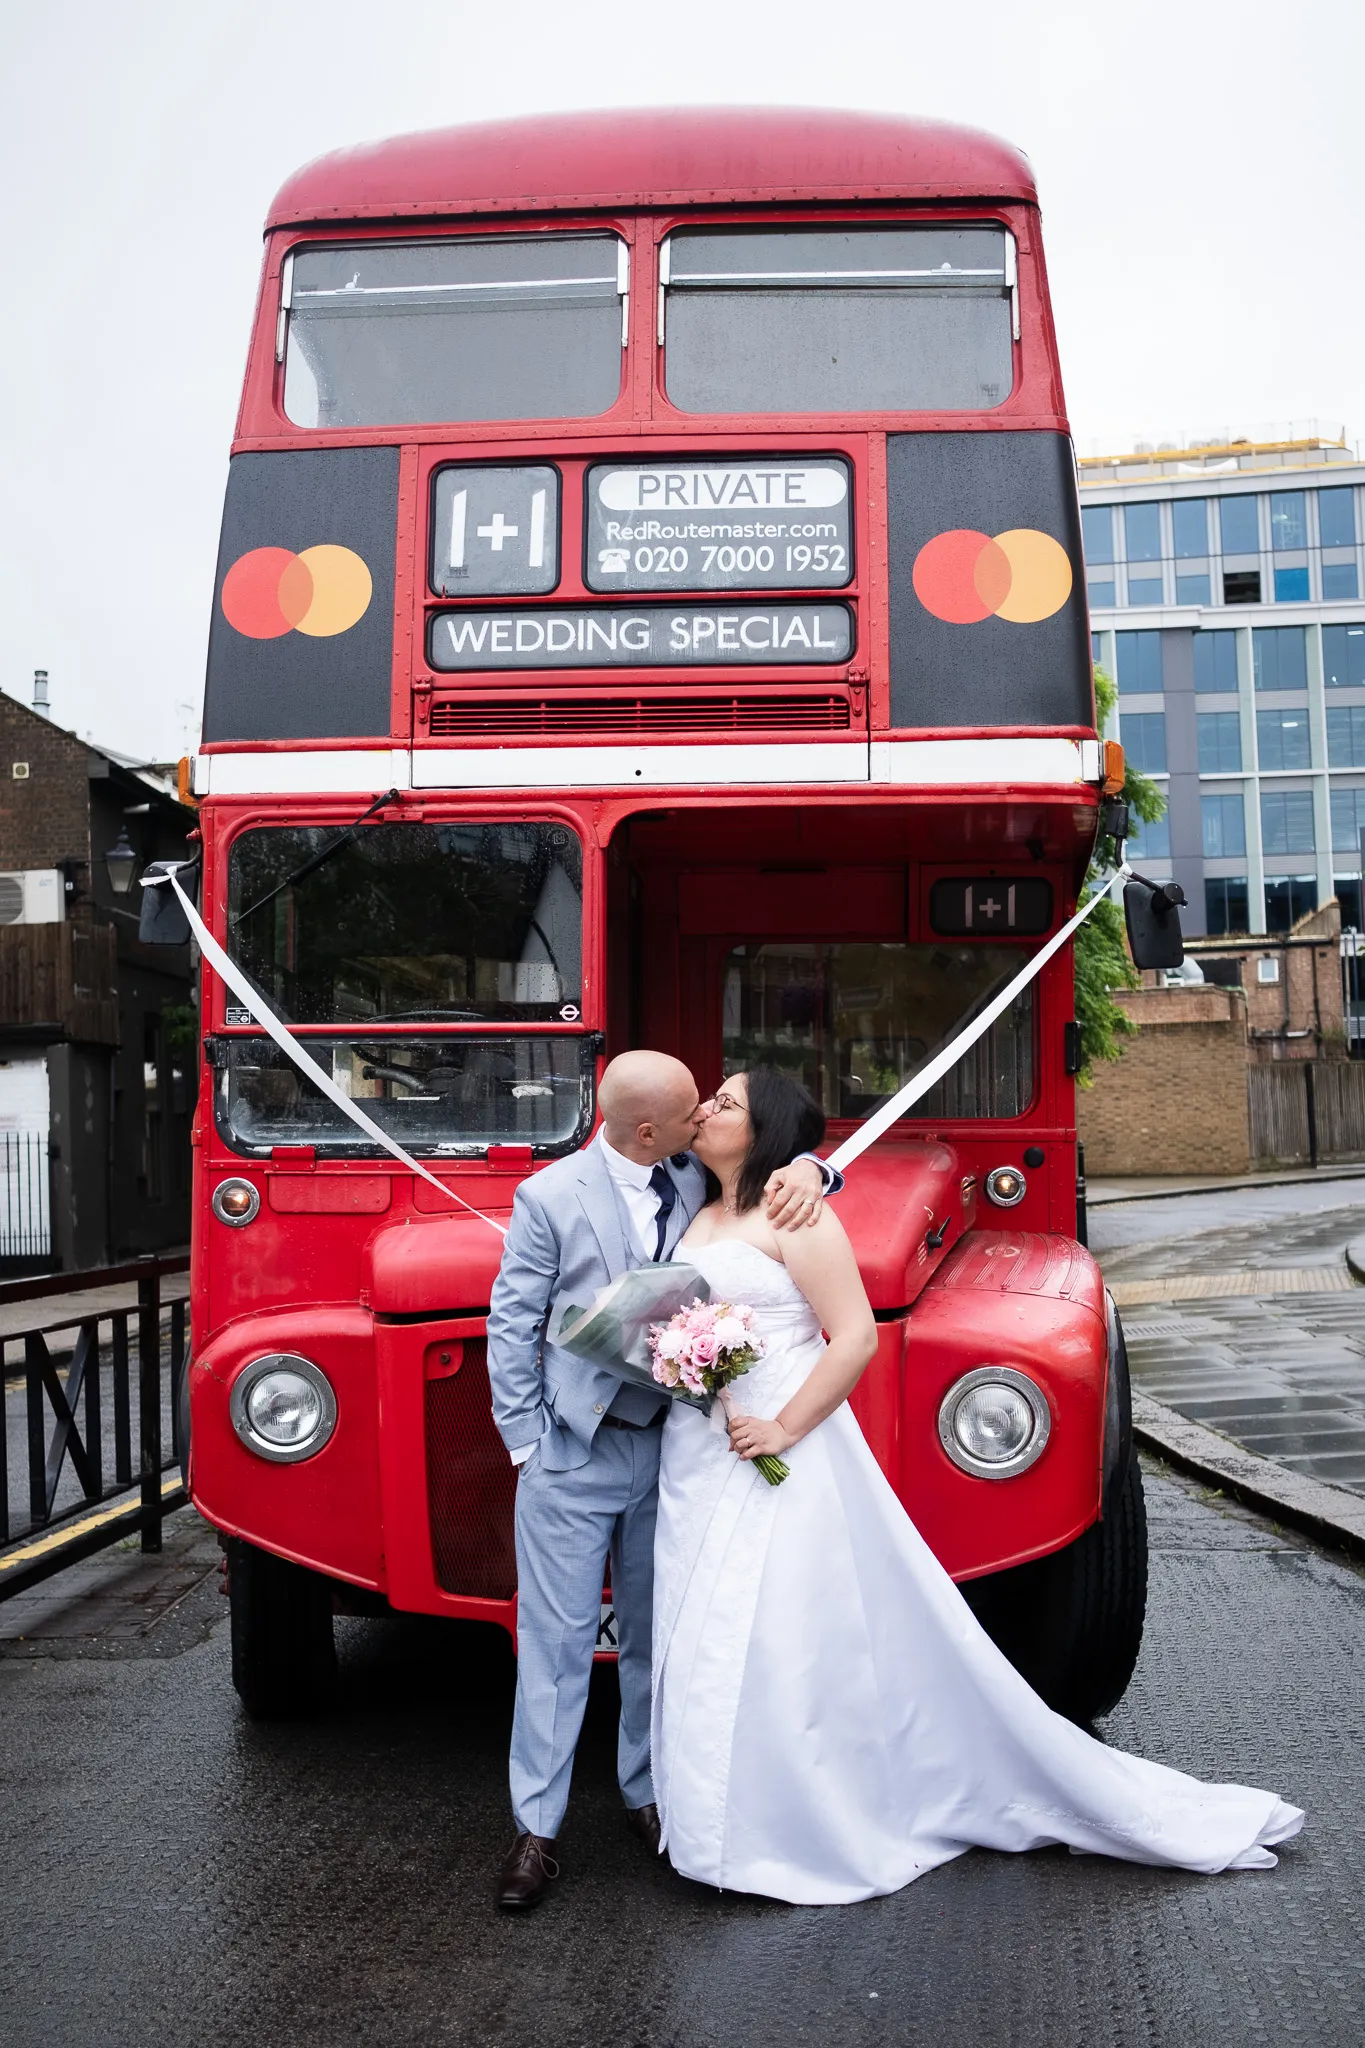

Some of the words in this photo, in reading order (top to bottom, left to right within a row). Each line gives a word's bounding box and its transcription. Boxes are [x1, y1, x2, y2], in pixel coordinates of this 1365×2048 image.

[637, 473, 807, 506] PRIVATE
[606, 521, 837, 541] RedRoutemaster.com
[634, 546, 689, 573] 020
[701, 545, 775, 573] 7000
[786, 544, 847, 572] 1952
[446, 617, 650, 653] WEDDING
[669, 615, 836, 650] SPECIAL
